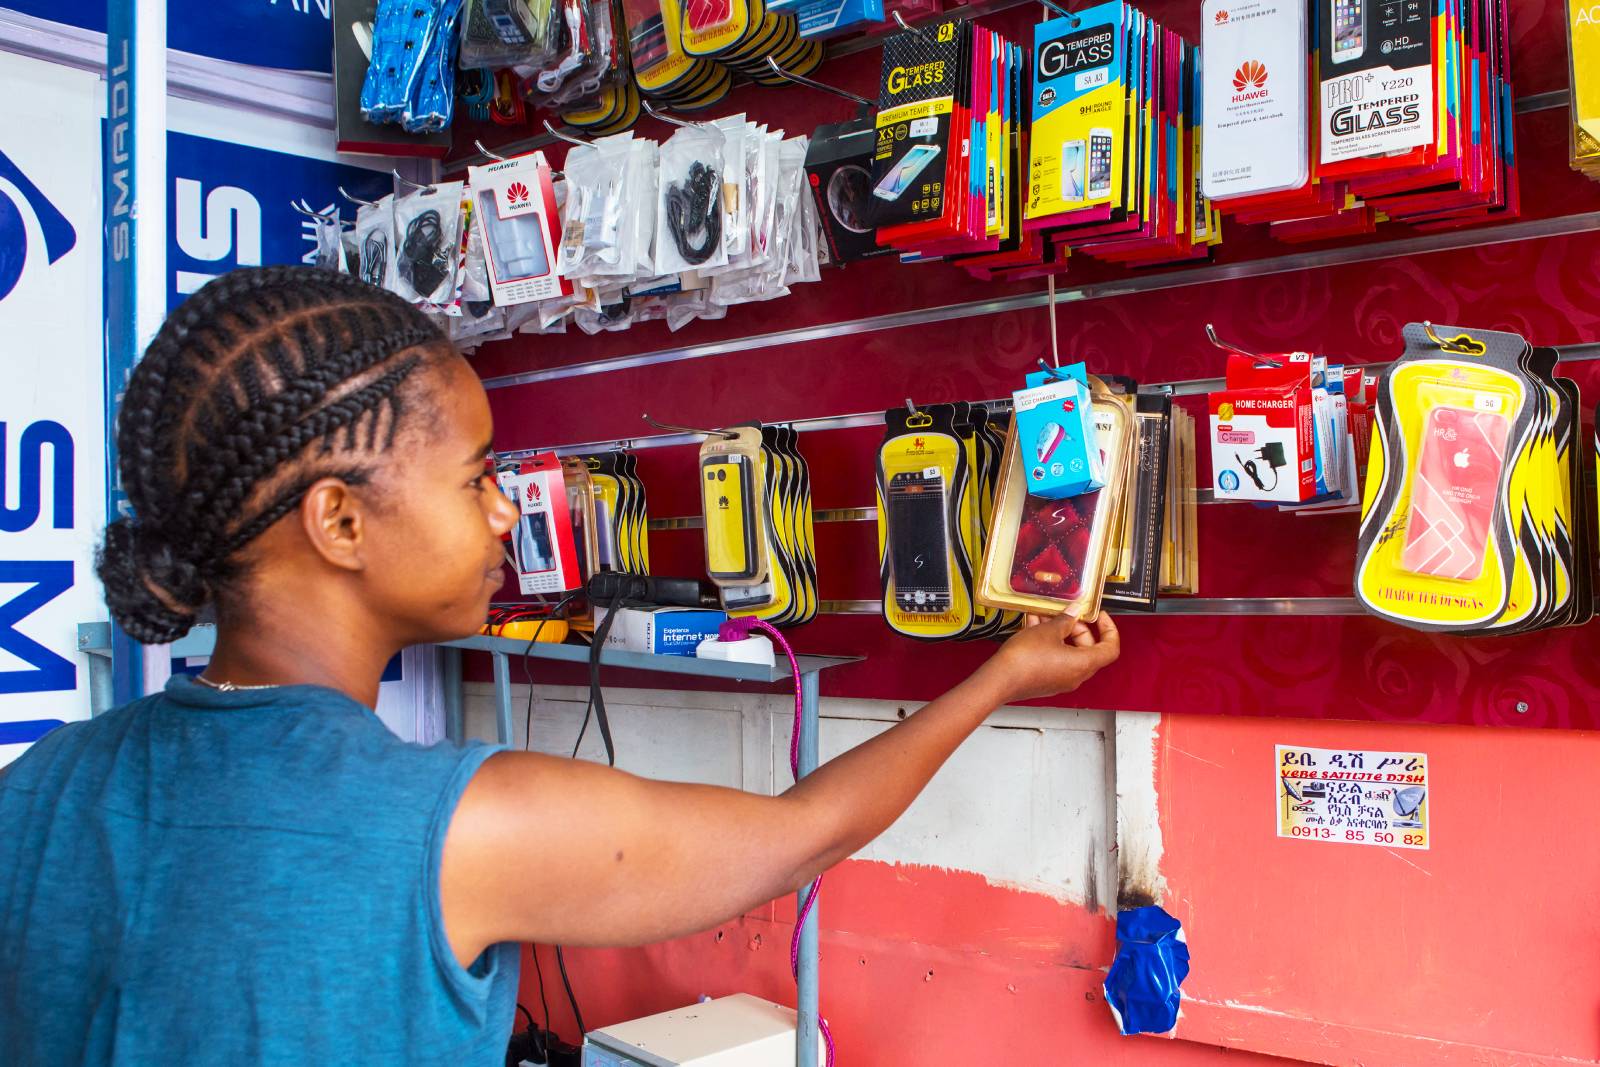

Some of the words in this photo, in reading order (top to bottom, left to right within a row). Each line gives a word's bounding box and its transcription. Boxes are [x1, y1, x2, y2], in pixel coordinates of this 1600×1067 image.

[1066, 32, 1111, 52] TEMEPRED
[1394, 36, 1409, 46] HD
[1039, 42, 1112, 77] GLASS
[904, 60, 945, 77] TEMPERED
[887, 66, 944, 95] GLASS
[1381, 77, 1413, 91] Y220
[1231, 89, 1269, 103] HUAWEI
[1357, 93, 1420, 112] TEMPERED
[1080, 106, 1092, 115] 9H
[1330, 103, 1420, 137] GLASS
[879, 126, 894, 140] XS
[488, 160, 519, 173] HUAWEI
[509, 202, 532, 211] HUAWEI
[1235, 400, 1256, 409] HOME
[1256, 400, 1294, 409] CHARGER
[1485, 400, 1494, 408] 5G
[663, 632, 703, 642] Internet
[1292, 826, 1336, 839] 0913-
[1345, 829, 1365, 841] 85
[1374, 832, 1394, 843] 50
[1403, 835, 1424, 846] 82
